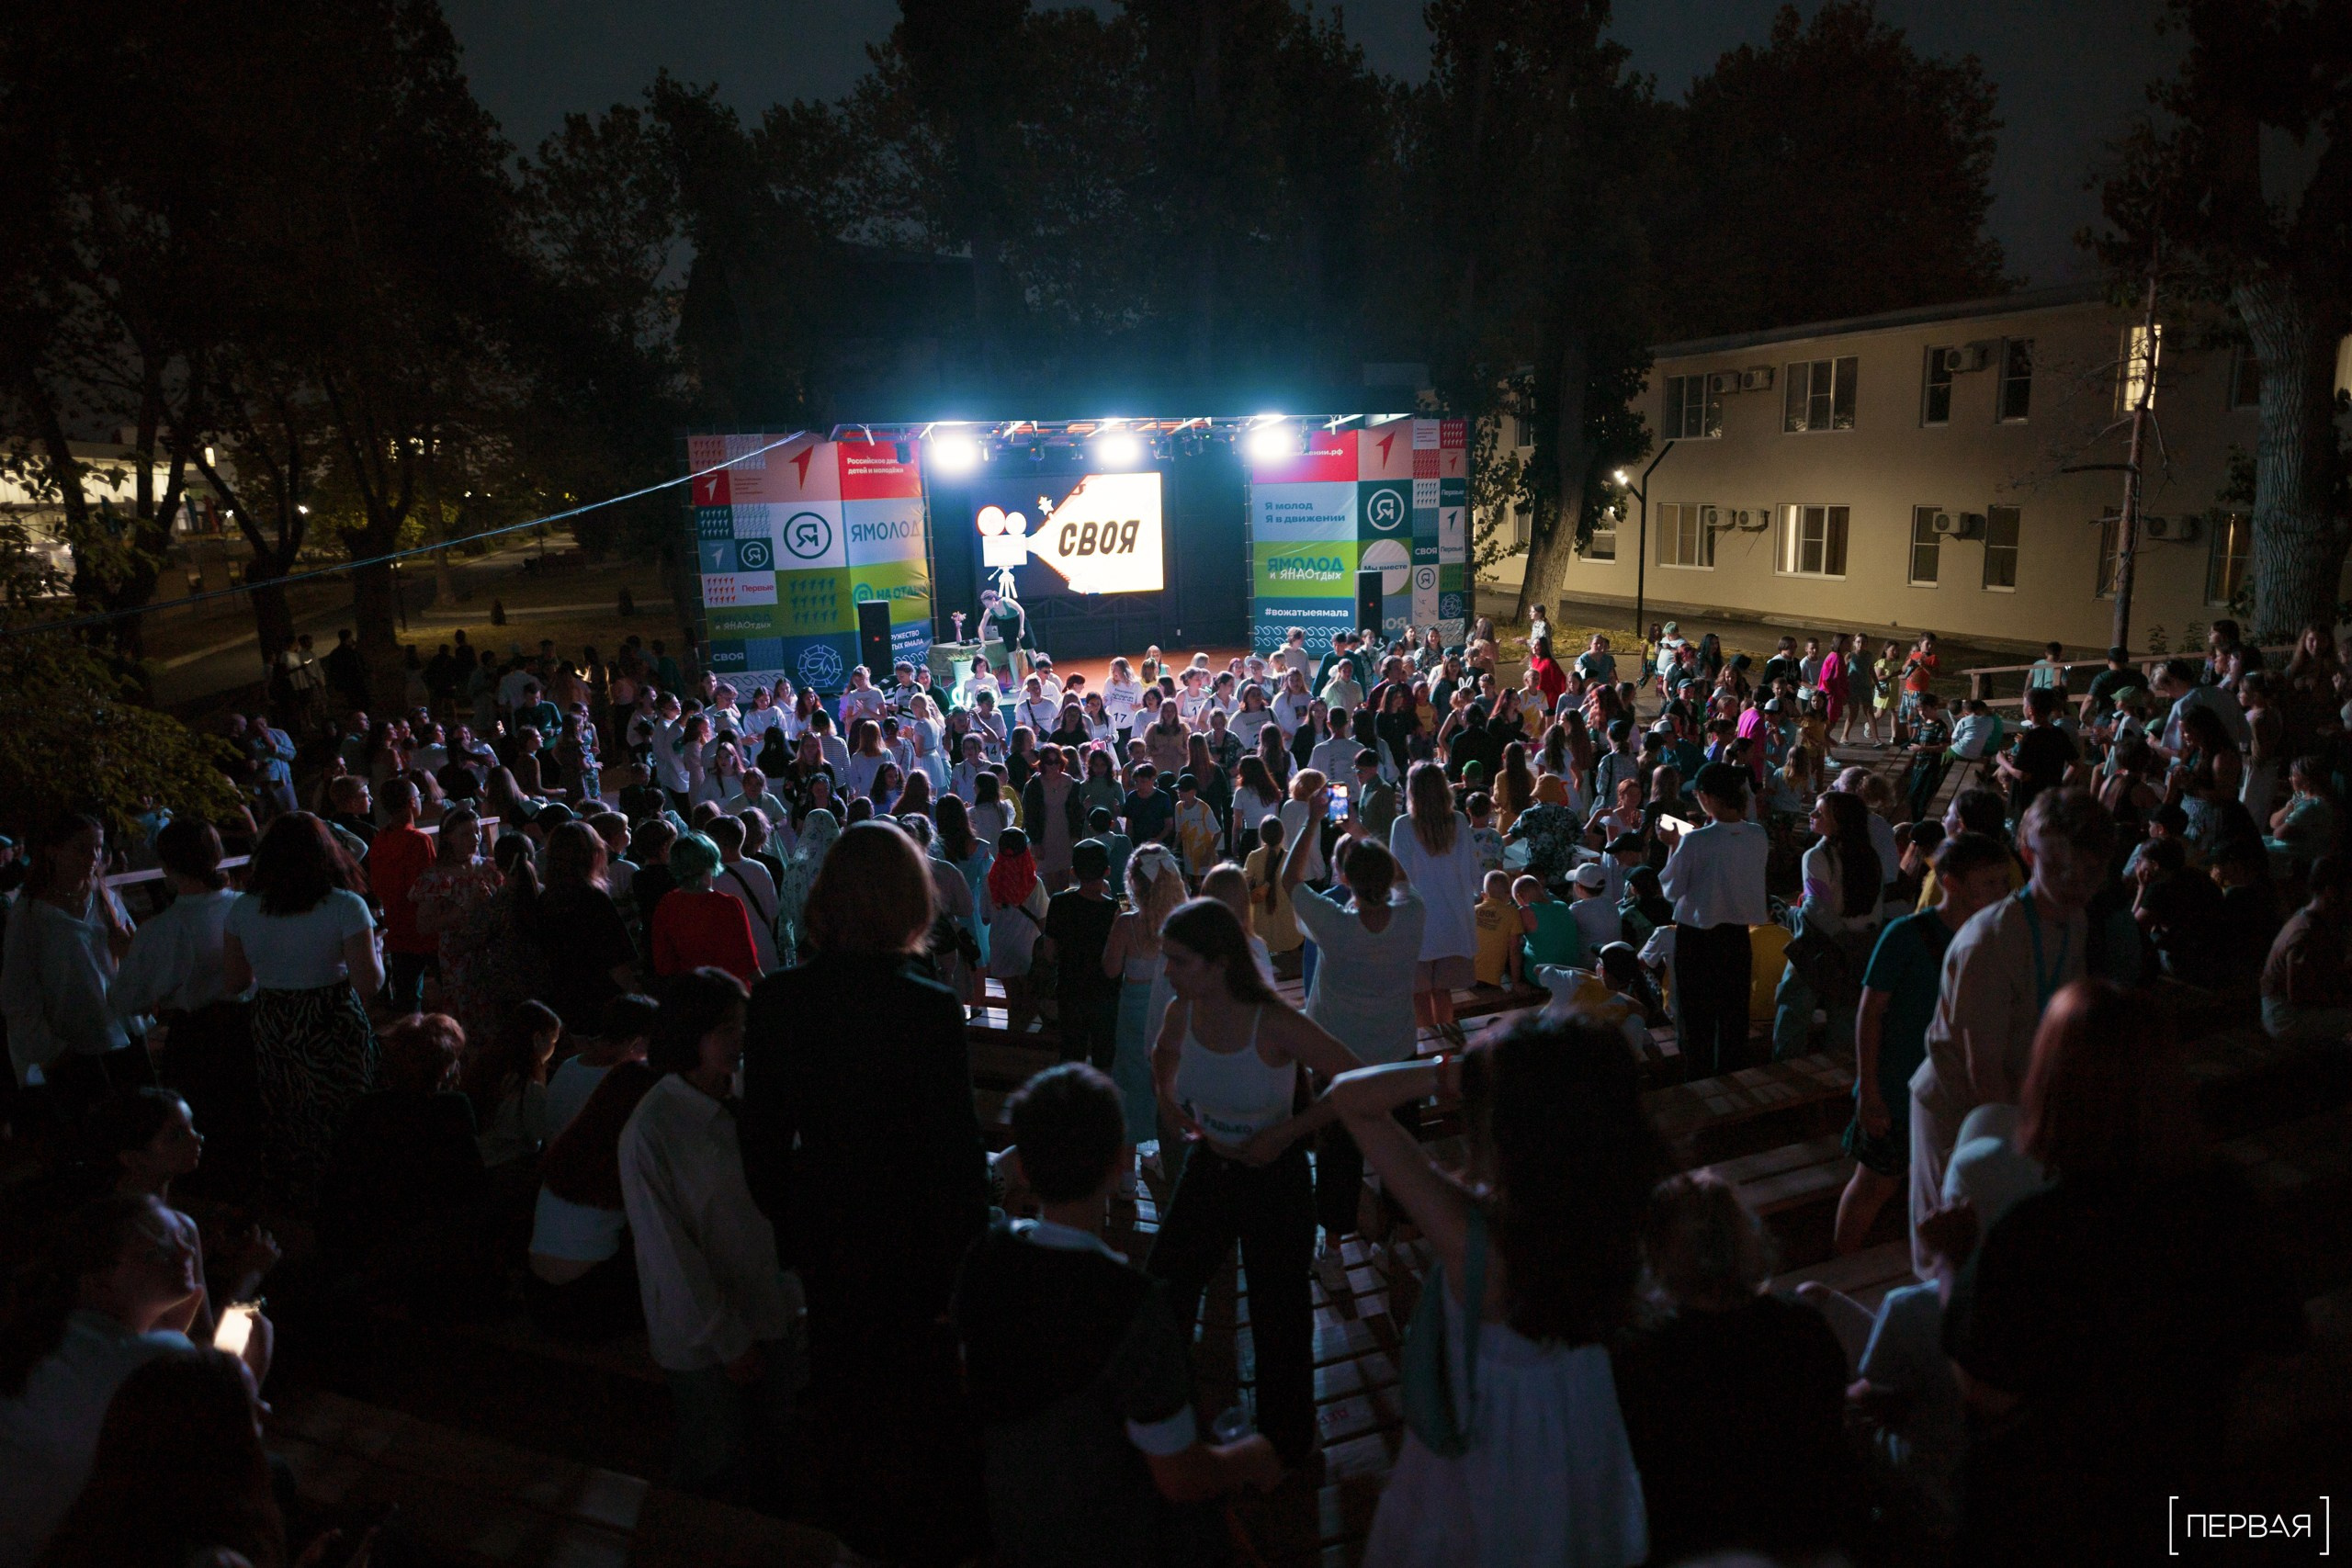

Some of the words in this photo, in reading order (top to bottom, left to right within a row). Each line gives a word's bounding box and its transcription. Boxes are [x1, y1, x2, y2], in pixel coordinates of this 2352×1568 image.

[847, 456, 886, 465] Российское
[848, 467, 867, 475] детей
[1265, 502, 1273, 511] Я
[1266, 514, 1273, 523] Я
[1284, 514, 1345, 524] движении
[1058, 519, 1140, 557] СВОЯ
[1415, 547, 1438, 556] СВОЯ
[1270, 571, 1276, 580] и
[741, 584, 774, 593] Первые
[1264, 607, 1349, 617] #вожатыеямала
[904, 637, 924, 649] ЯМАЛА
[713, 652, 744, 661] СВОЯ
[1114, 712, 1127, 723] 17
